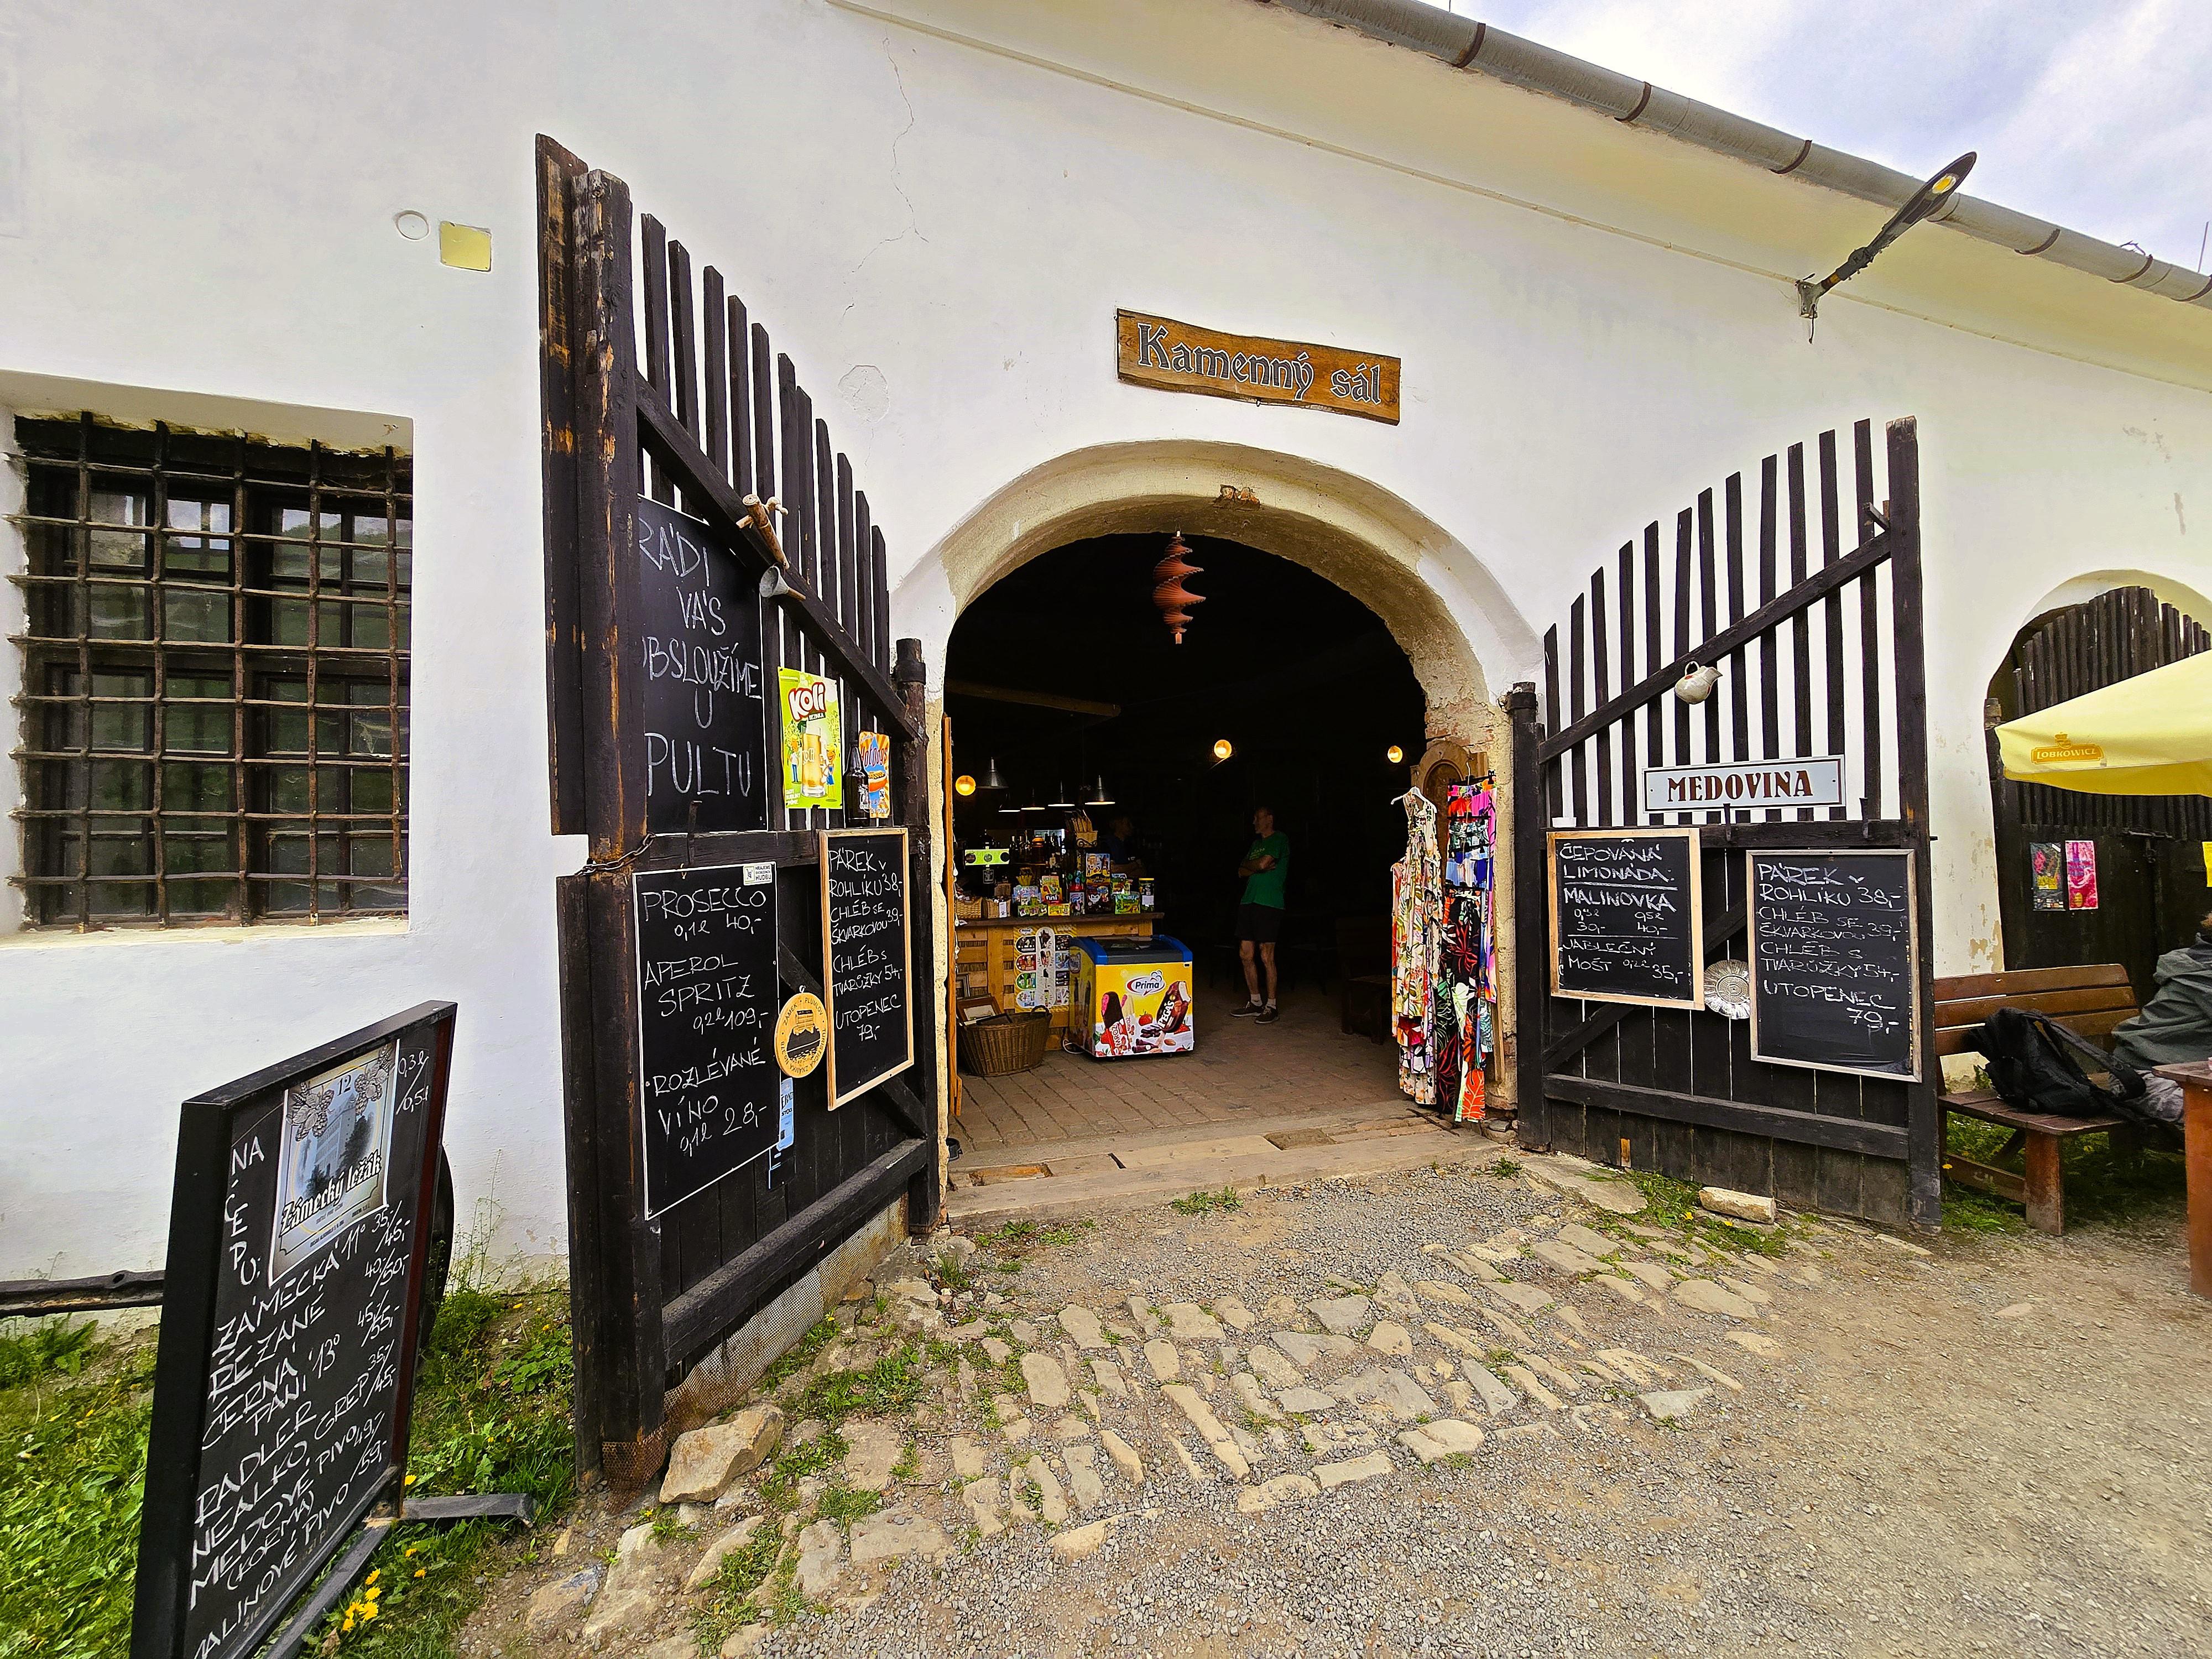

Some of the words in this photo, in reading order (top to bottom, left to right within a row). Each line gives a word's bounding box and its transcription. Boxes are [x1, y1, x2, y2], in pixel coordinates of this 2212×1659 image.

[1137, 322, 1314, 401] Kamenný
[1330, 362, 1381, 405] sál
[676, 586, 726, 635] VÁS
[643, 636, 762, 700] BSLOUŽÍME
[695, 688, 713, 729] U
[2037, 748, 2097, 759] LOBKOWICZ
[1667, 770, 1813, 802] MEDOVINA
[828, 847, 877, 873] PÁREK
[1560, 843, 1662, 862] ČEPOVANÁ
[829, 874, 882, 898] ROHLÍKU
[1757, 863, 1844, 886] PÁREK
[641, 887, 766, 921] PROSECCO
[1563, 887, 1677, 912] MALINOVKA
[1759, 883, 1851, 906] ROHLÍKU
[726, 913, 761, 935] 40,-
[830, 899, 871, 922] CHLÉB
[1759, 906, 1829, 924] CHLÉB
[1836, 916, 1863, 928] SE
[831, 921, 888, 945] ŠKVARKOVOU
[1577, 921, 1605, 934] 30,-
[1637, 921, 1668, 935] 40,-
[833, 945, 879, 973] CHLÉB
[1563, 938, 1656, 956] JABLEČNÝ
[1760, 941, 1840, 957] CHLÉB
[644, 954, 739, 990] APEROL
[1568, 955, 1612, 971] MOŠT
[1652, 964, 1683, 984] 35,-
[658, 974, 755, 1017] SPRITZ
[805, 998, 823, 1015] PLUMLOV
[1764, 979, 1896, 1010] UTOPENEC
[836, 994, 901, 1029] UTOPENEC
[653, 1036, 766, 1097] ROZLÉVANÉ
[337, 1074, 352, 1097] 12
[658, 1095, 718, 1136] VÍNO
[231, 1135, 265, 1176] NA
[279, 1171, 345, 1238] Zámecký
[345, 1149, 382, 1193] ležák
[212, 1238, 340, 1358] ZÁMECKÁ
[195, 1400, 317, 1528] RADLER
[314, 1372, 369, 1440] GREP
[189, 1457, 314, 1610] MEDOVÉ
[315, 1425, 357, 1475] PIVO
[301, 1483, 349, 1546] PIVO
